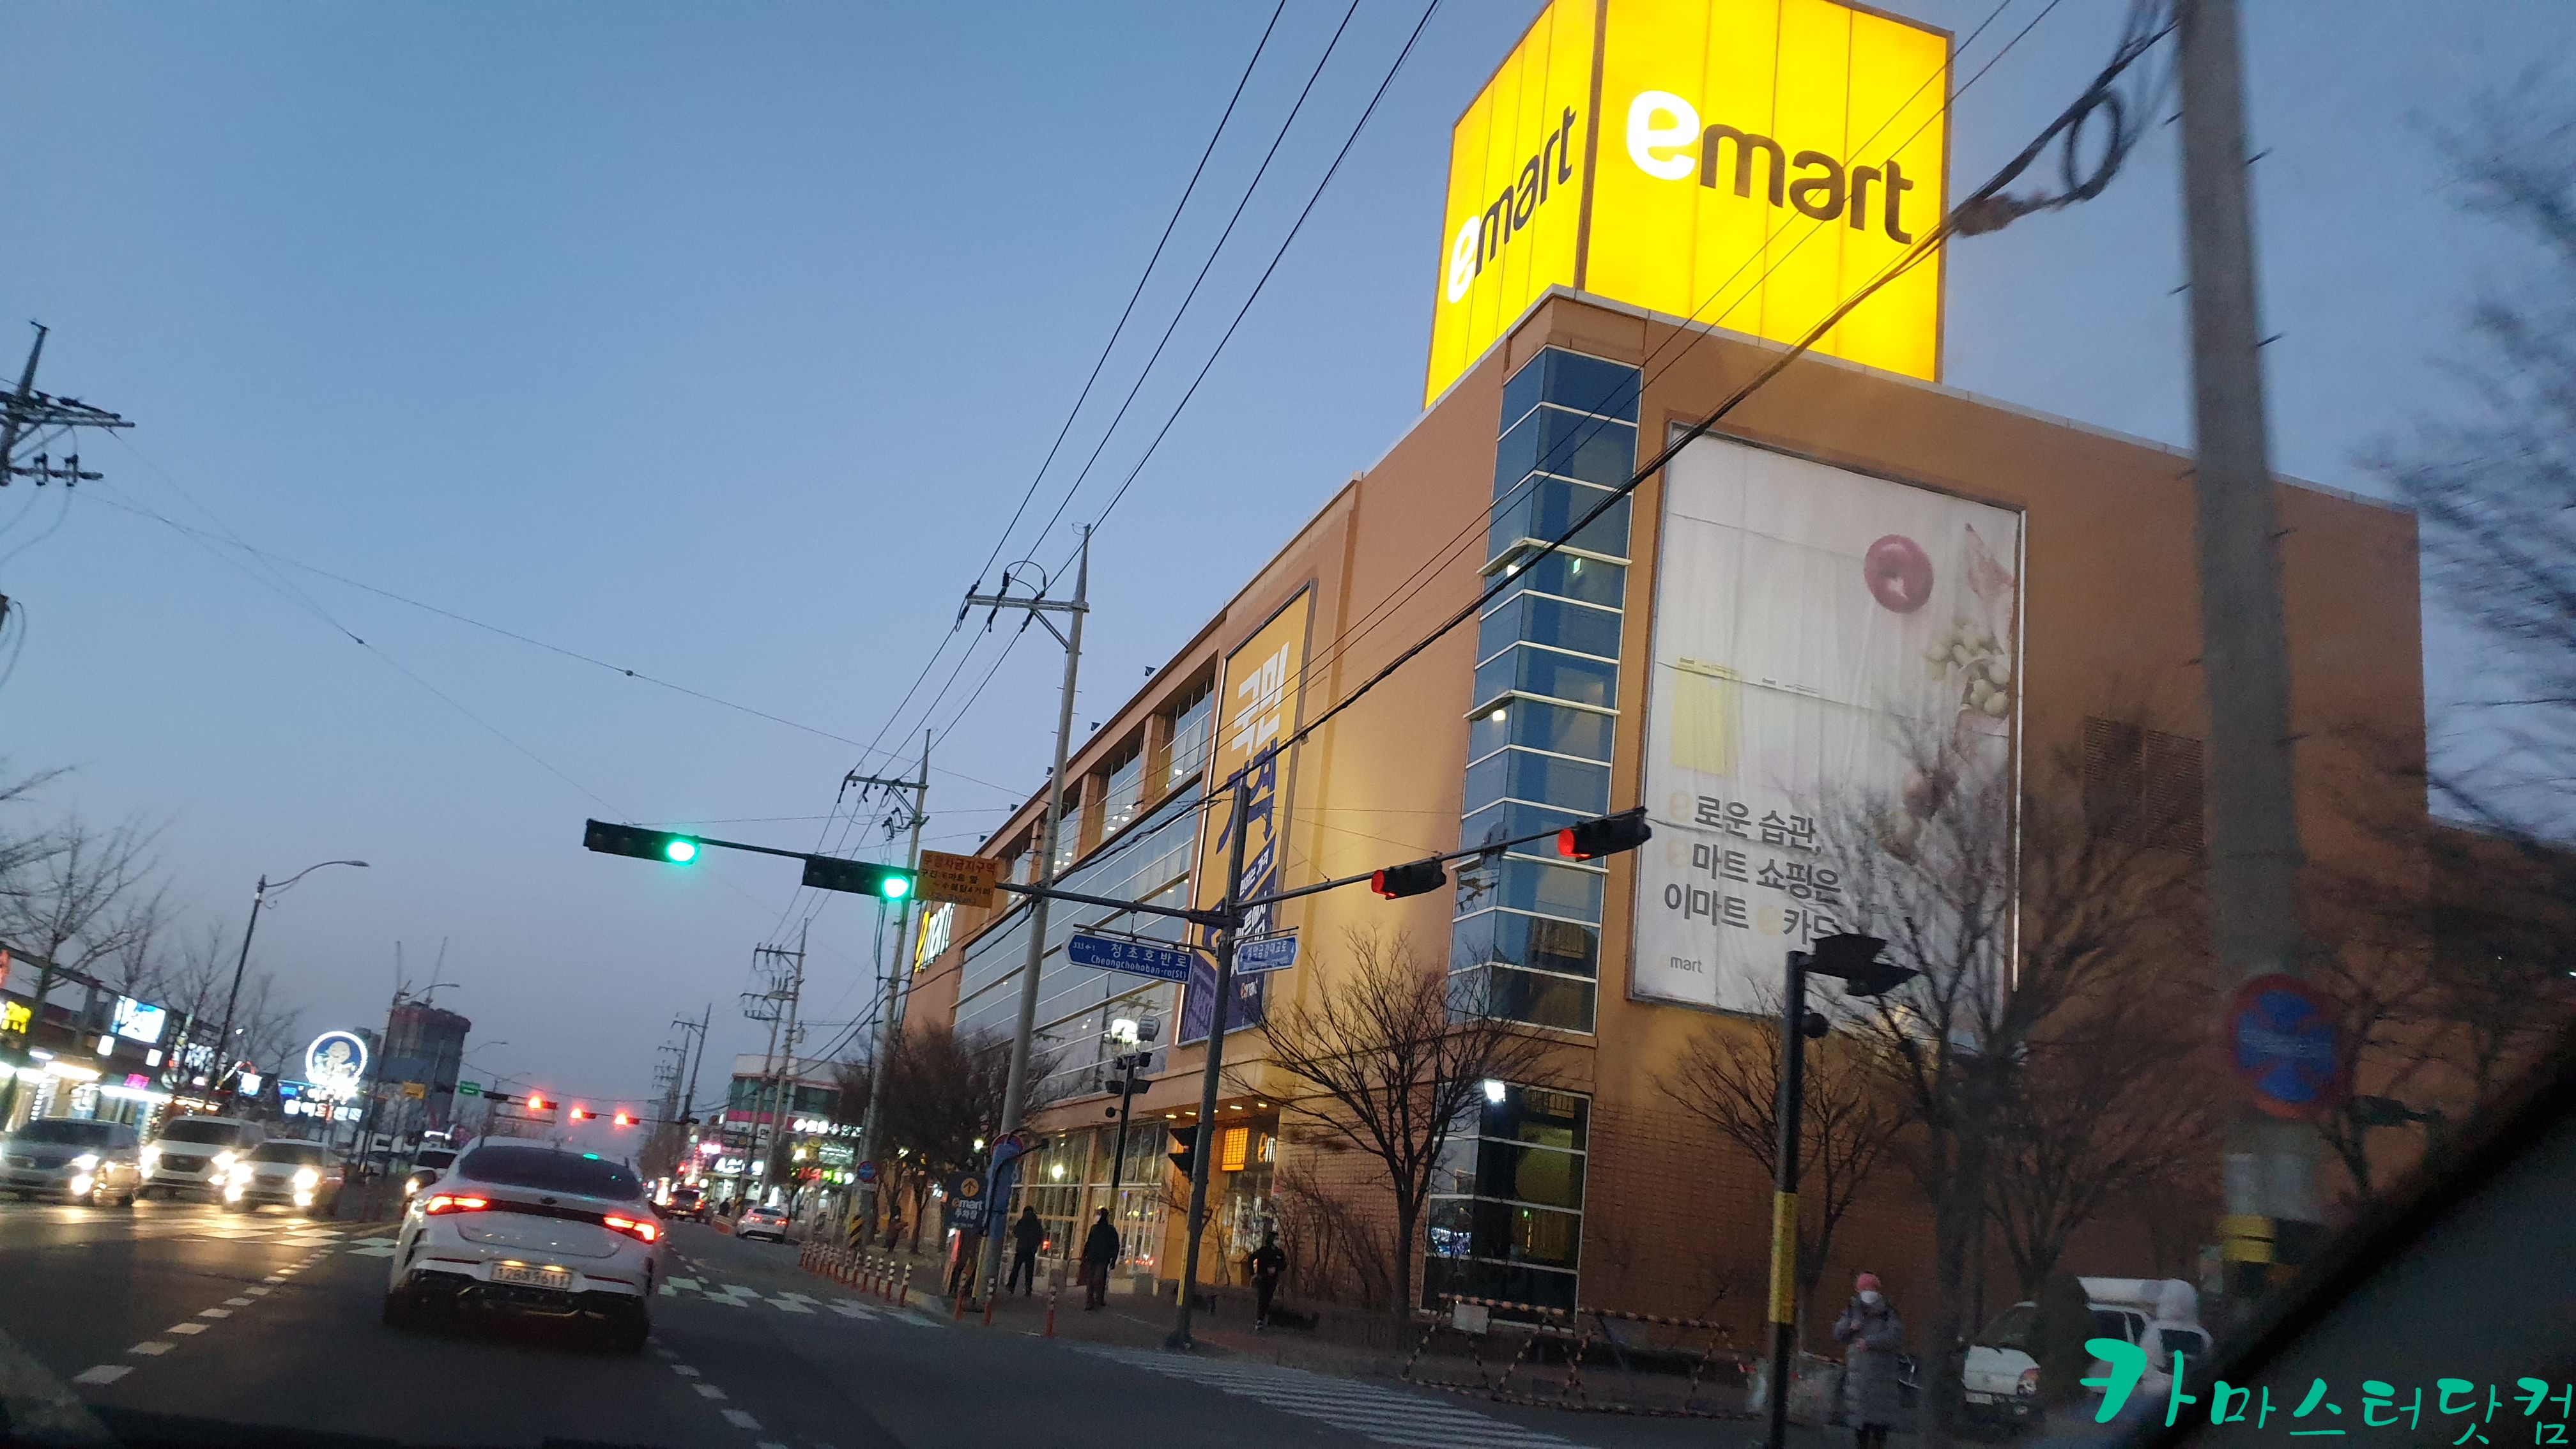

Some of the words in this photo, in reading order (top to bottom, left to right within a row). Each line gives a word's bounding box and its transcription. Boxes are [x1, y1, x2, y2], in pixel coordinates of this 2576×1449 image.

[1626, 89, 1913, 245] emart
[1447, 105, 1576, 303] emart
[1231, 641, 1289, 756] 국민
[1756, 859, 1841, 905] 쇼핑은
[1664, 883, 1749, 929] 이마트
[1091, 954, 1187, 981] Cheongchohoban-ro(St)
[1110, 942, 1187, 967] 청초호반로
